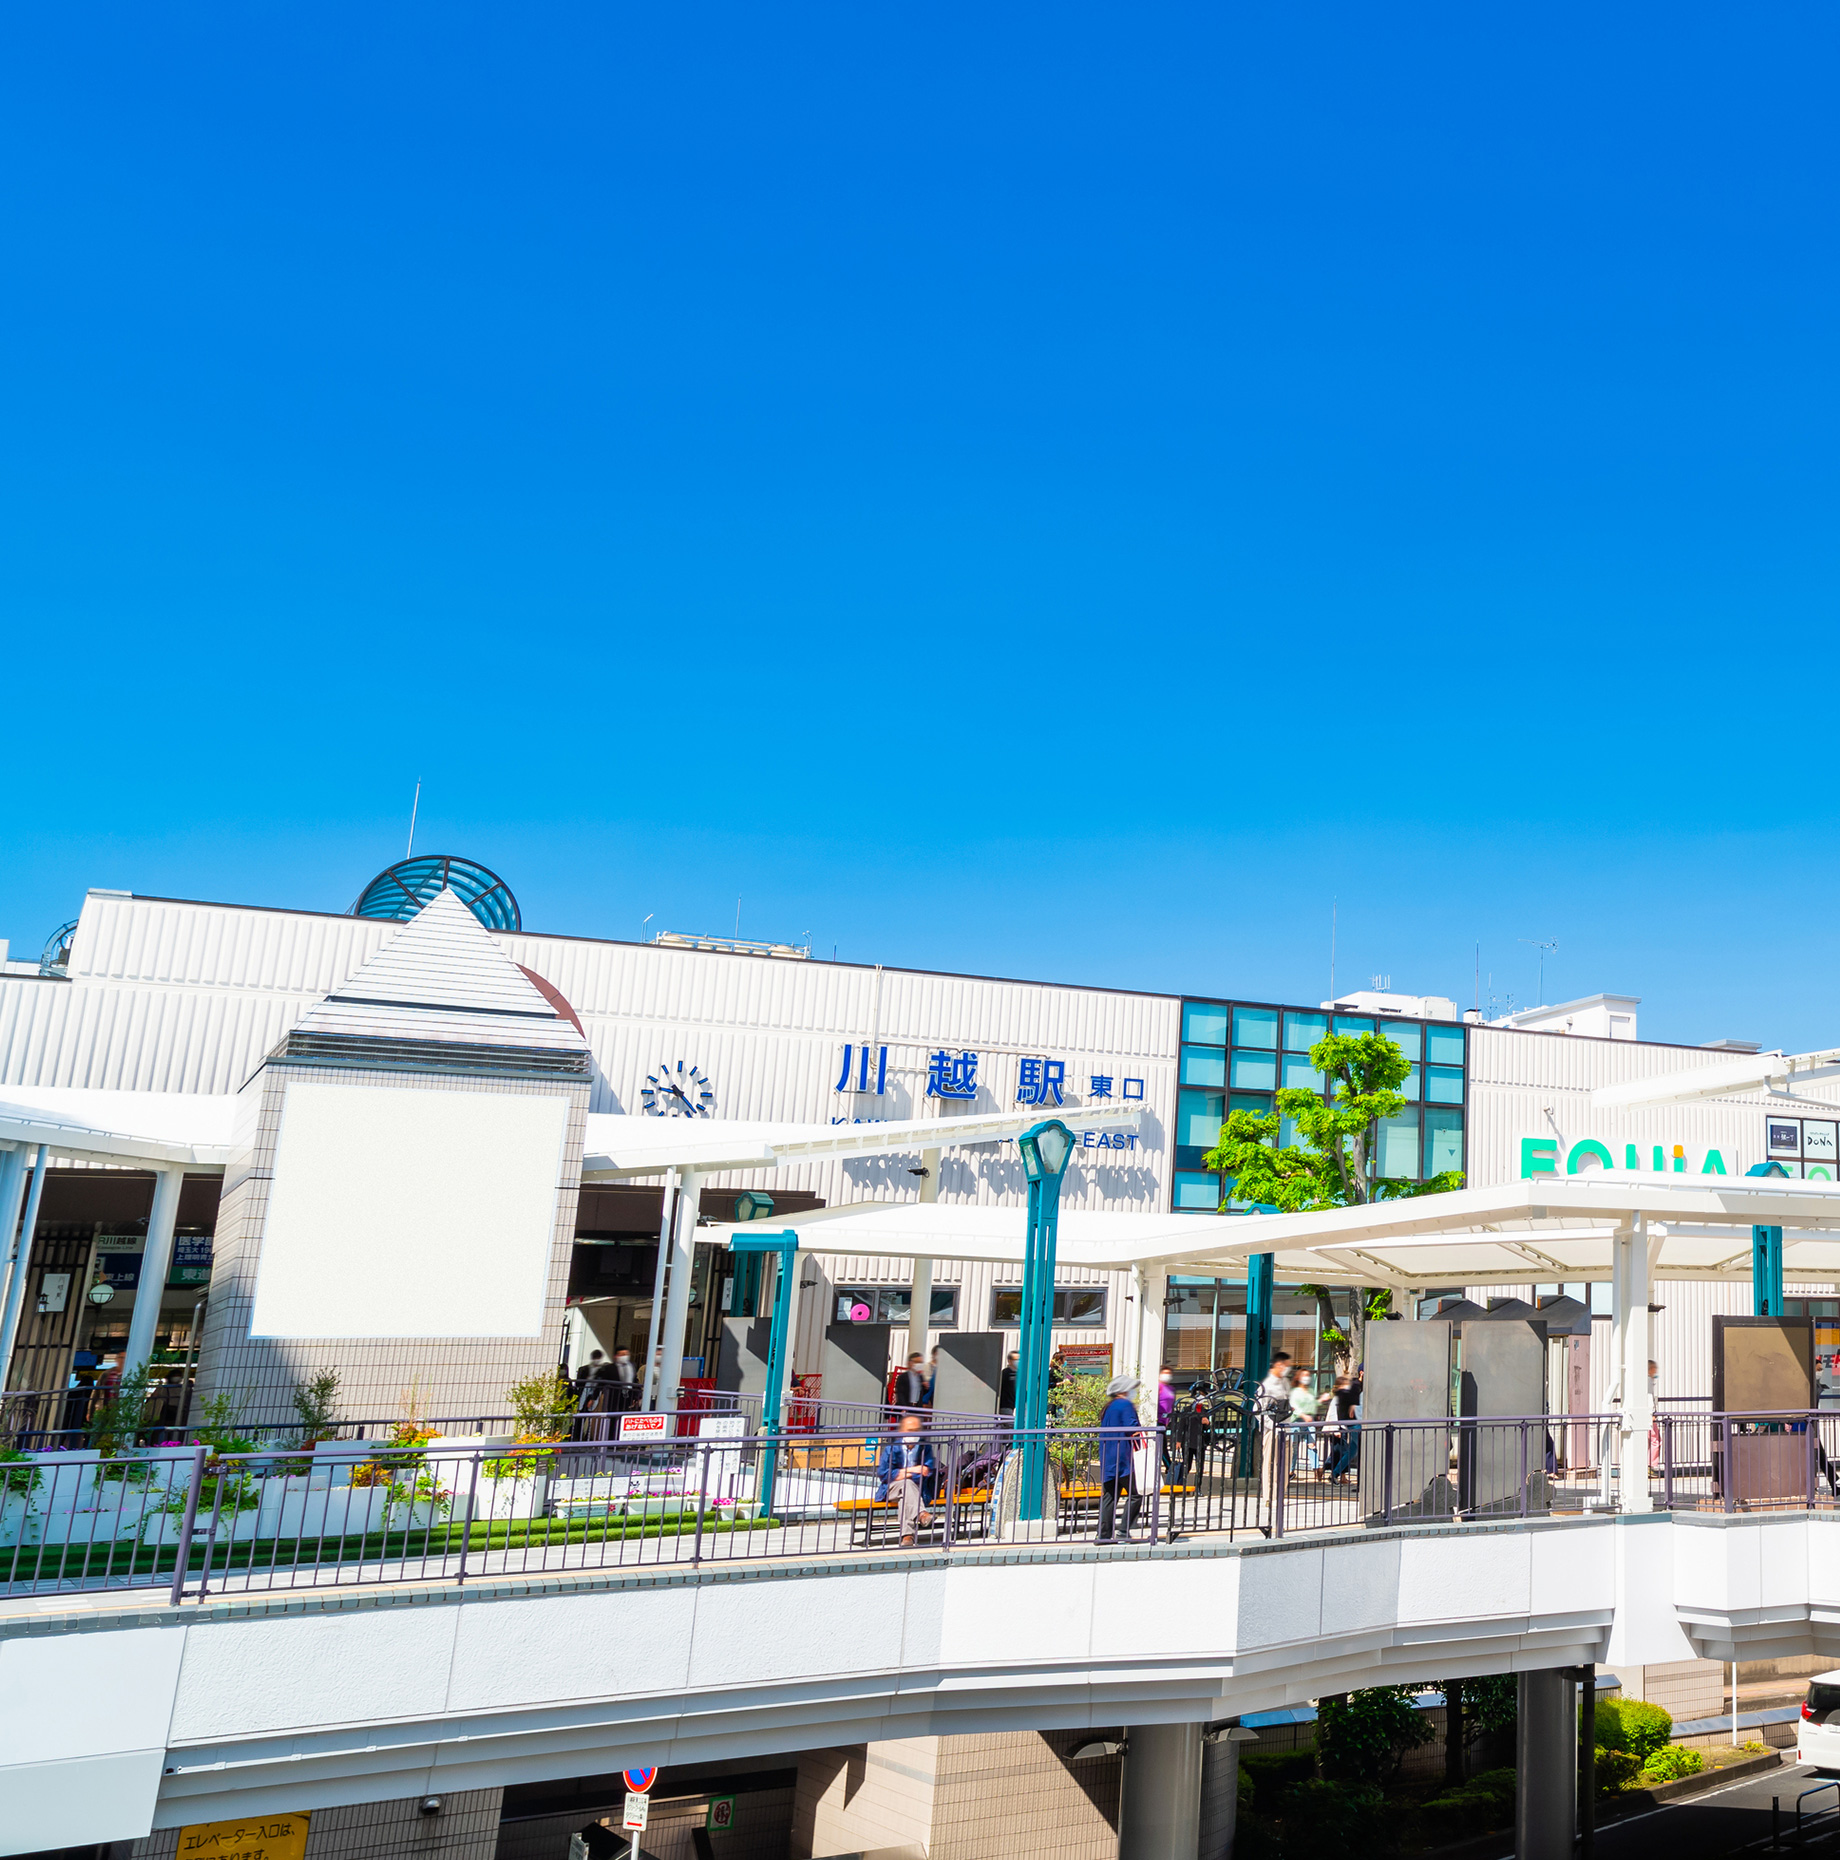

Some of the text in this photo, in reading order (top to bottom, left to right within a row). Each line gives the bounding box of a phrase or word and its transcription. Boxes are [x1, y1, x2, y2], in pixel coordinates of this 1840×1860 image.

[835, 1043, 1145, 1107] 川越駅 東口
[1083, 1132, 1139, 1151] EAST
[184, 1823, 295, 1850] エレベーター入口は、
